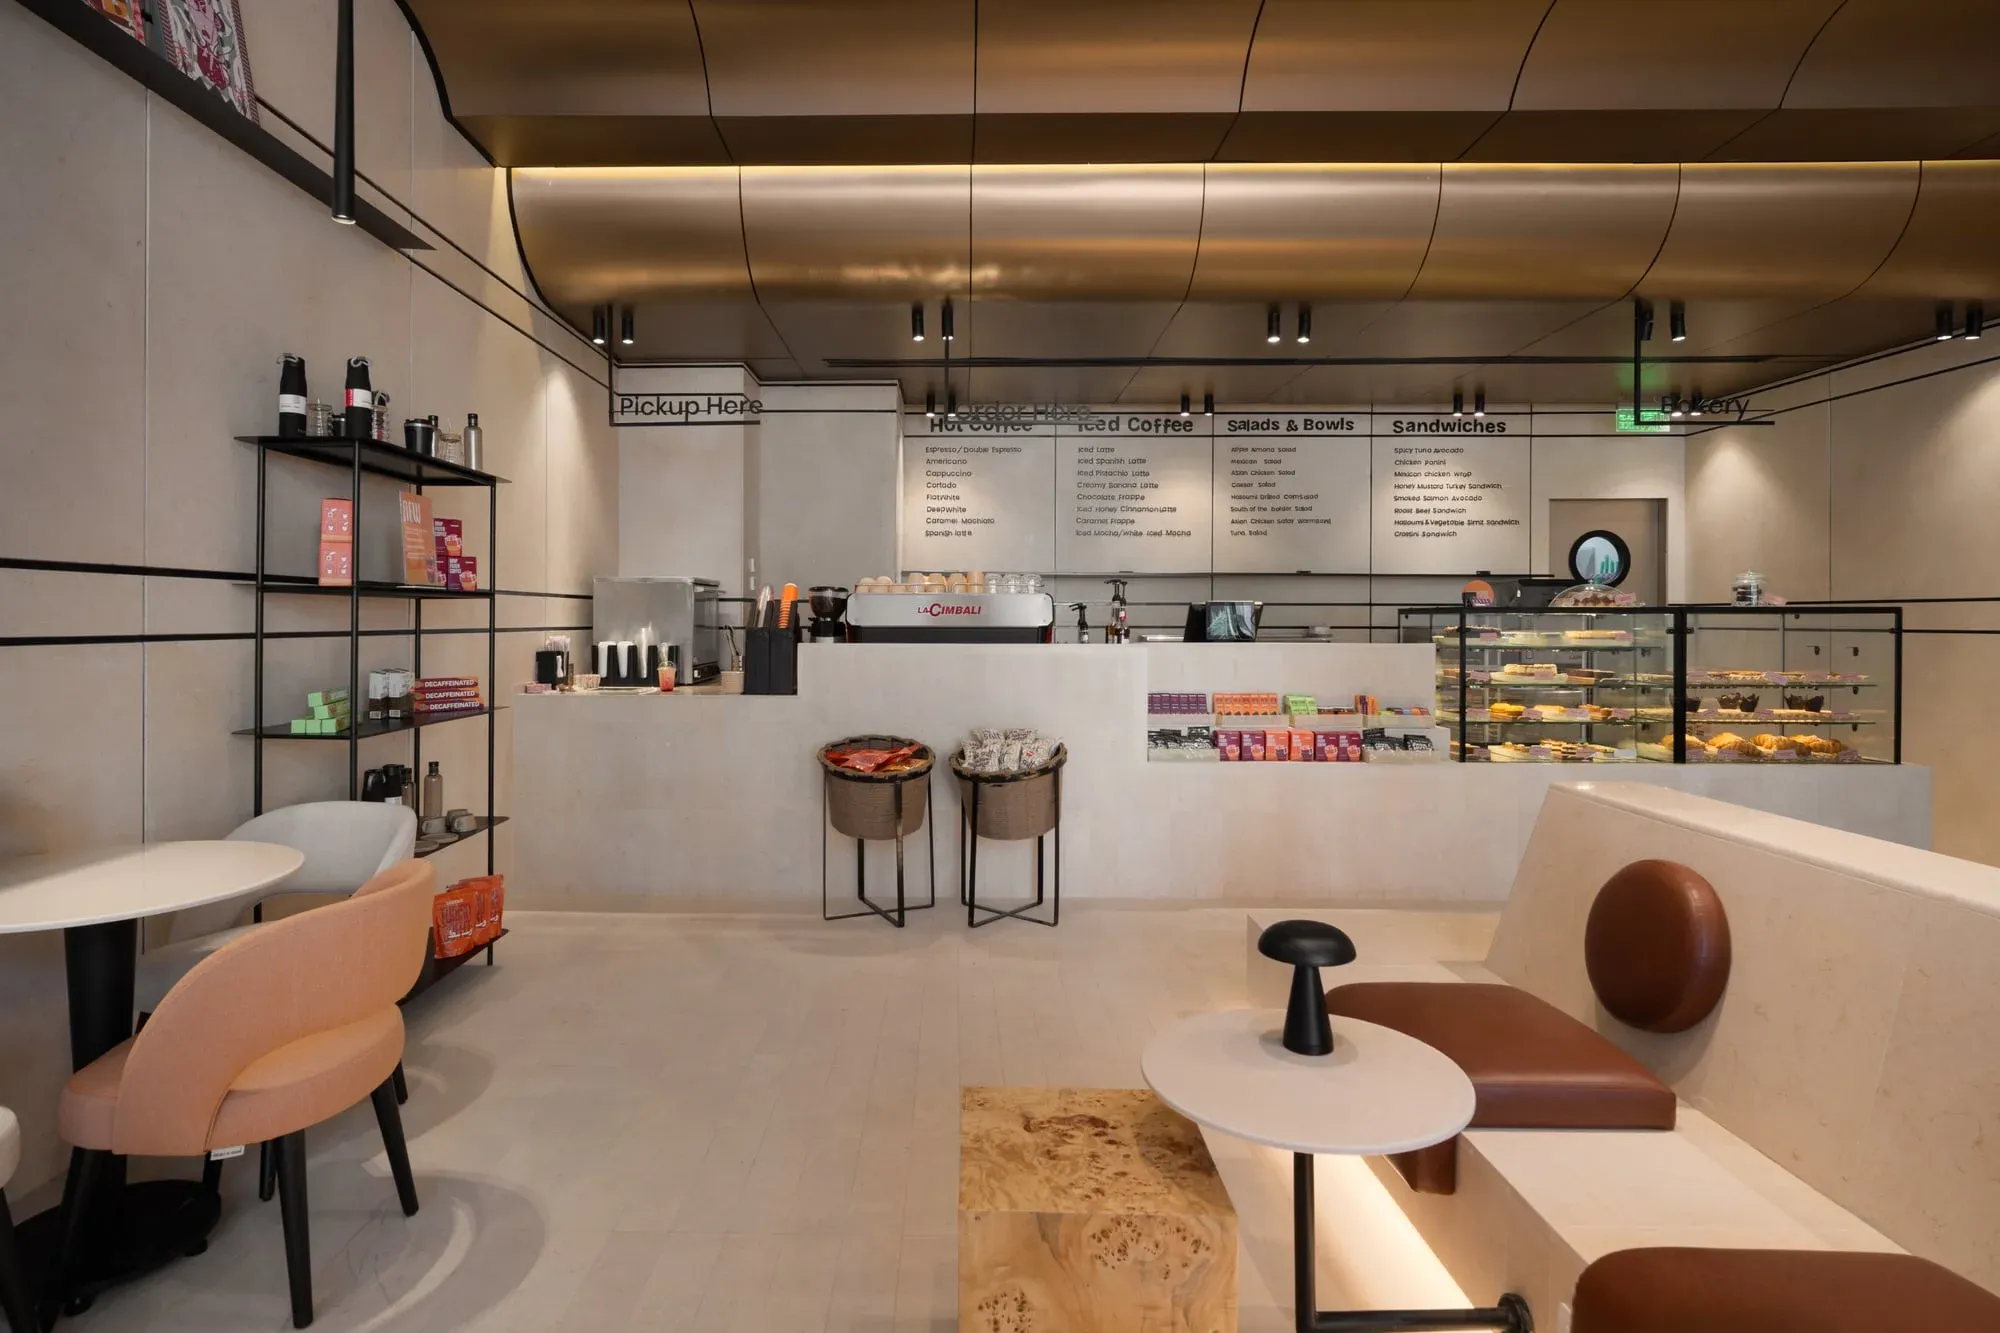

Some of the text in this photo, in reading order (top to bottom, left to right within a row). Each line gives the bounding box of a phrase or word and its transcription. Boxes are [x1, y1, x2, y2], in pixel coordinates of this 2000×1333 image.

[620, 396, 763, 422] Pickup Here
[956, 402, 1092, 421] Order Here
[1661, 395, 1750, 421] Bakery
[1078, 416, 1194, 433] Iced Coffee
[1227, 417, 1355, 432] Salads & Bowls
[1392, 418, 1507, 434] Sandwiches
[925, 469, 972, 478] Cappuccino
[926, 481, 957, 489] Cortado
[1140, 481, 1159, 489] Latte
[930, 603, 982, 617] CIMBALI
[424, 680, 474, 688] DECAFFEINATED
[425, 691, 475, 699] DECAFFEINATED
[429, 702, 480, 710] DECAFFEINATED
